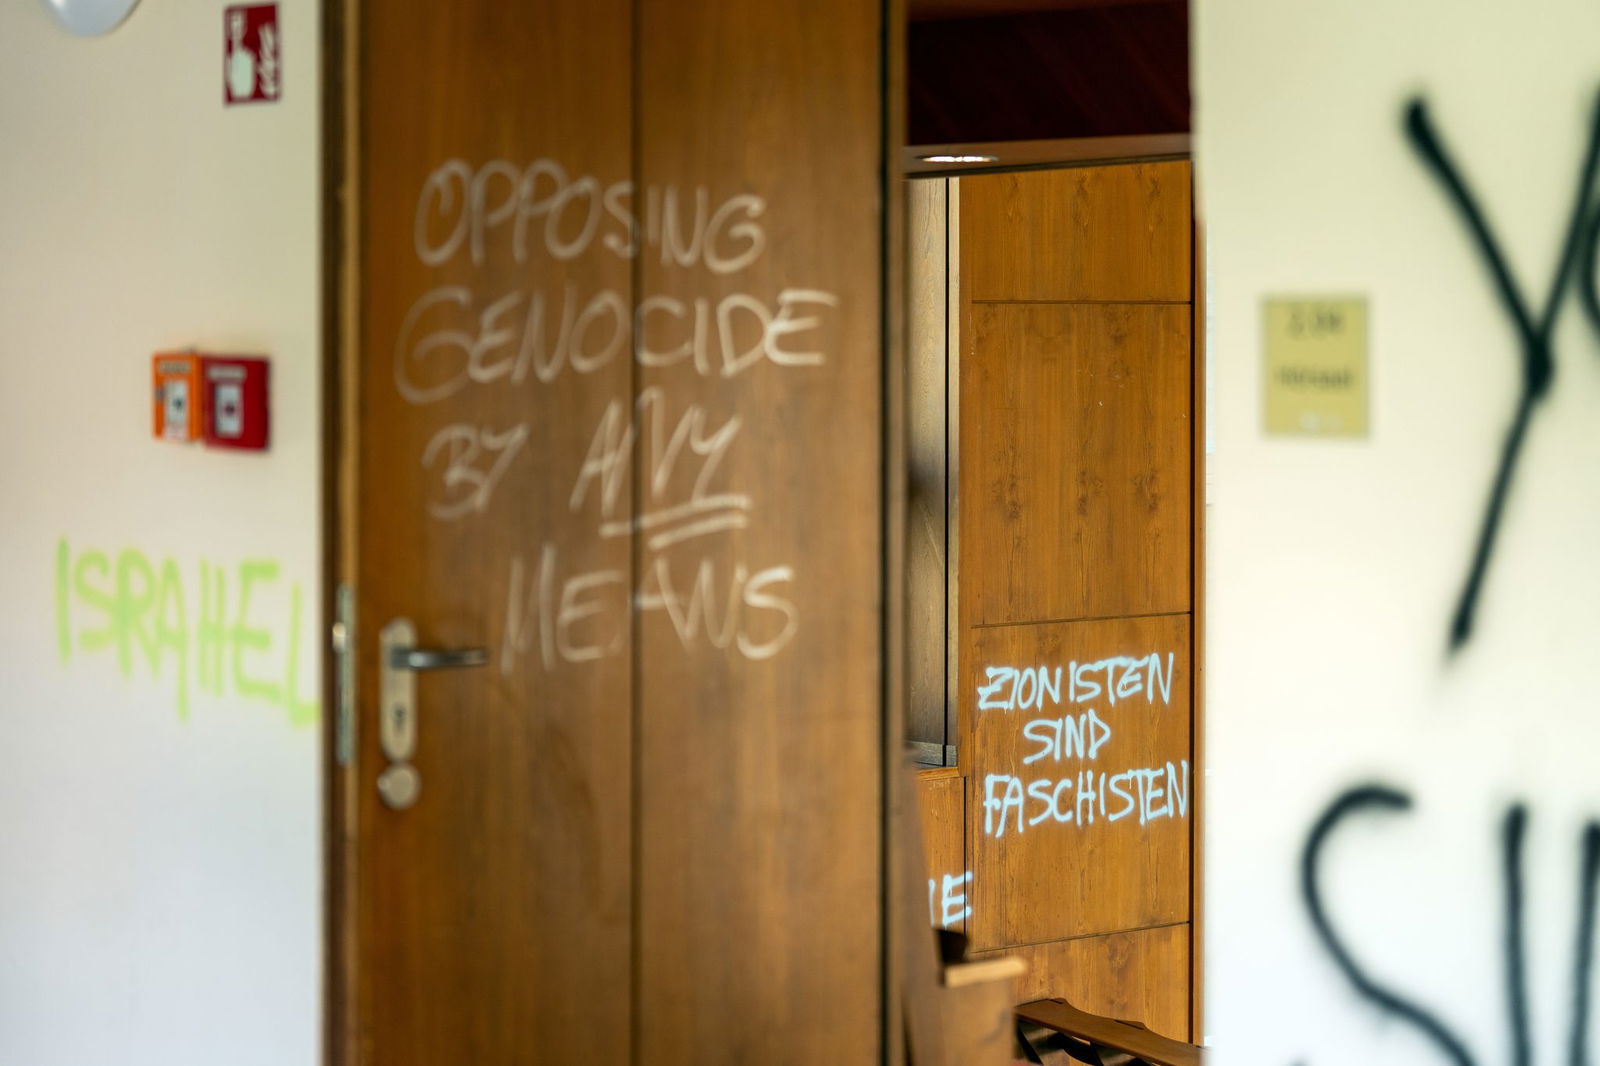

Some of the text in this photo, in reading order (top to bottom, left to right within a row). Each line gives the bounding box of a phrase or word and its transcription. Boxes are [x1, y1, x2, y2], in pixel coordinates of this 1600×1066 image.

[413, 158, 766, 274] OPPOSING
[394, 285, 837, 404] GENOCIDE
[422, 385, 743, 521] BY ANY
[500, 542, 798, 674] MEANS
[977, 652, 1174, 712] ZIONISTEN
[1023, 708, 1111, 765] SIND
[983, 759, 1188, 838] FASCHISTEN
